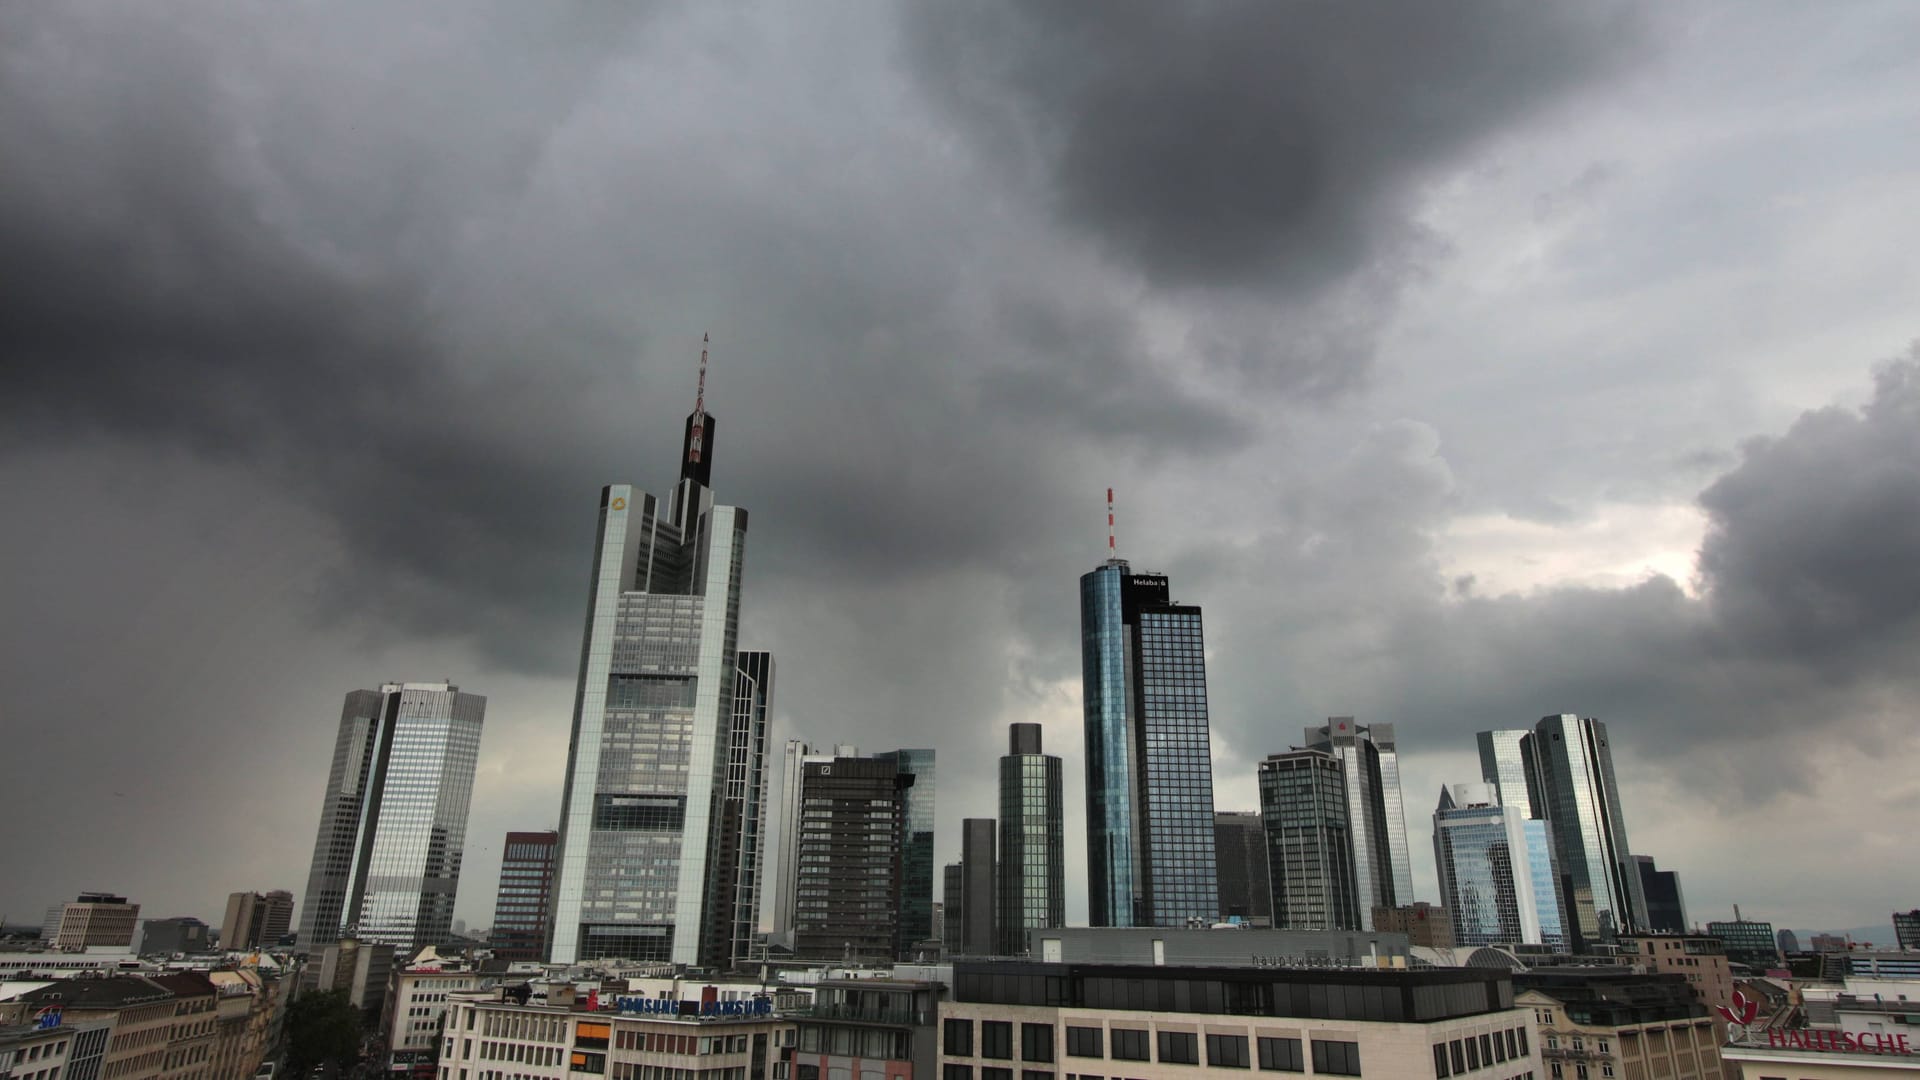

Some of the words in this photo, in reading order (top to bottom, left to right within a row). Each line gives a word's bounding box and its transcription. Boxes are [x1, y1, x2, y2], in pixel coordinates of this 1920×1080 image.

[1133, 578, 1158, 587] Helaba
[617, 996, 679, 1015] SAMSUNG
[703, 997, 772, 1016] SAMSUNG
[1767, 1027, 1912, 1056] HALLESCHE
